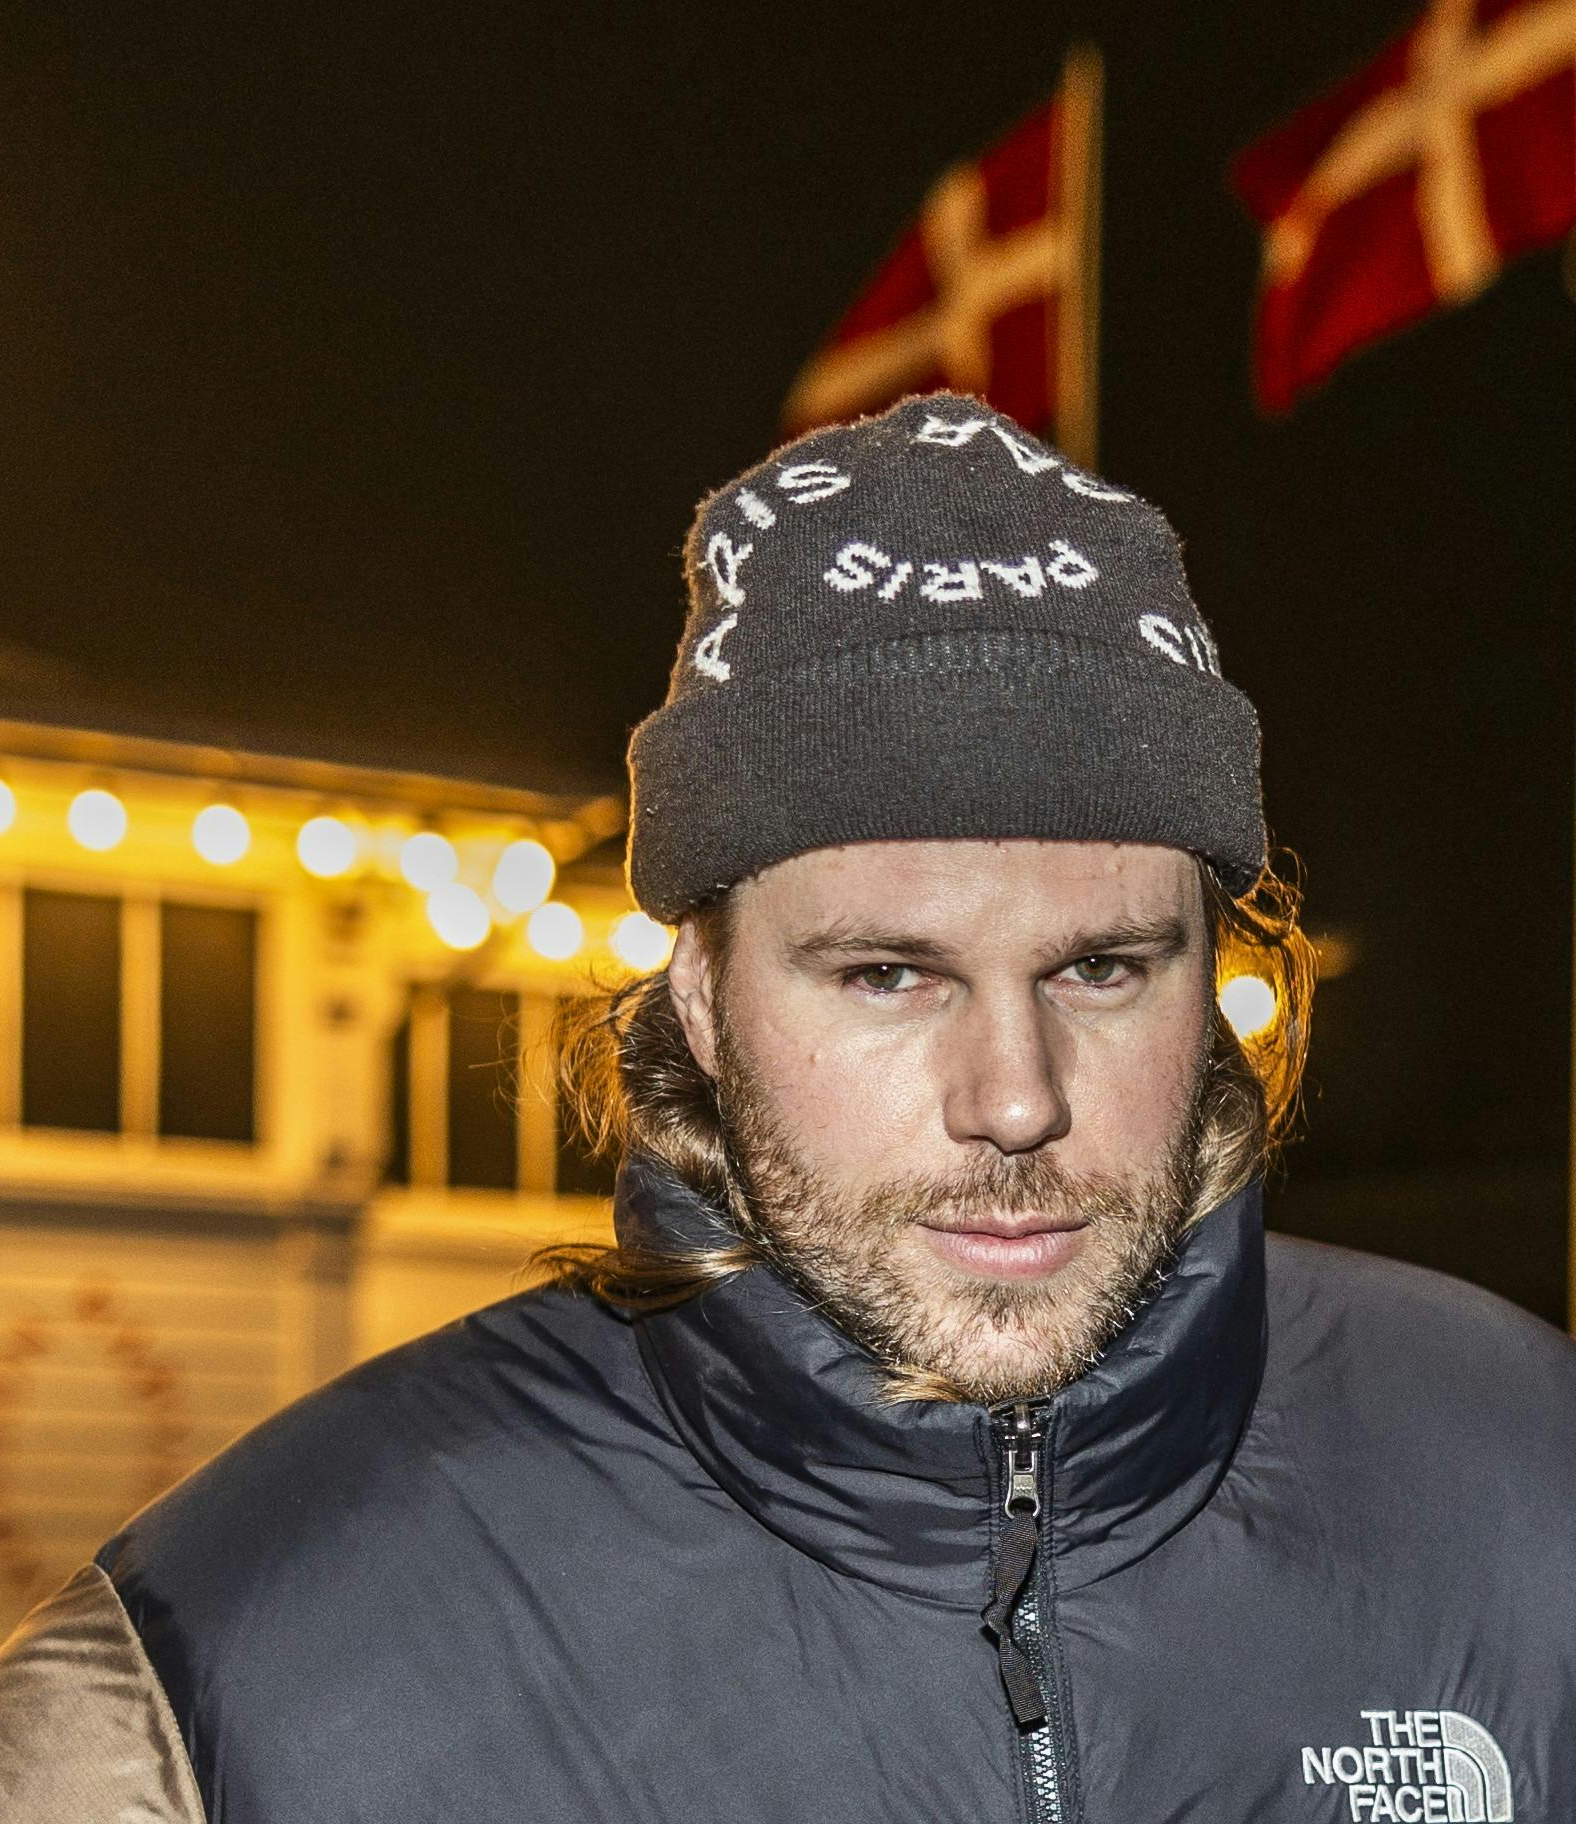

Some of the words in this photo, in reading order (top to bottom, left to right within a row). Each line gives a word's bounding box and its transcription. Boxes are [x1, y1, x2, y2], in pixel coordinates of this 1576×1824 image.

[694, 461, 851, 682] ARIS
[823, 539, 1099, 602] PARIS
[1360, 1710, 1441, 1748] THE
[1301, 1746, 1444, 1785] NORTH
[1348, 1785, 1448, 1823] FACE
